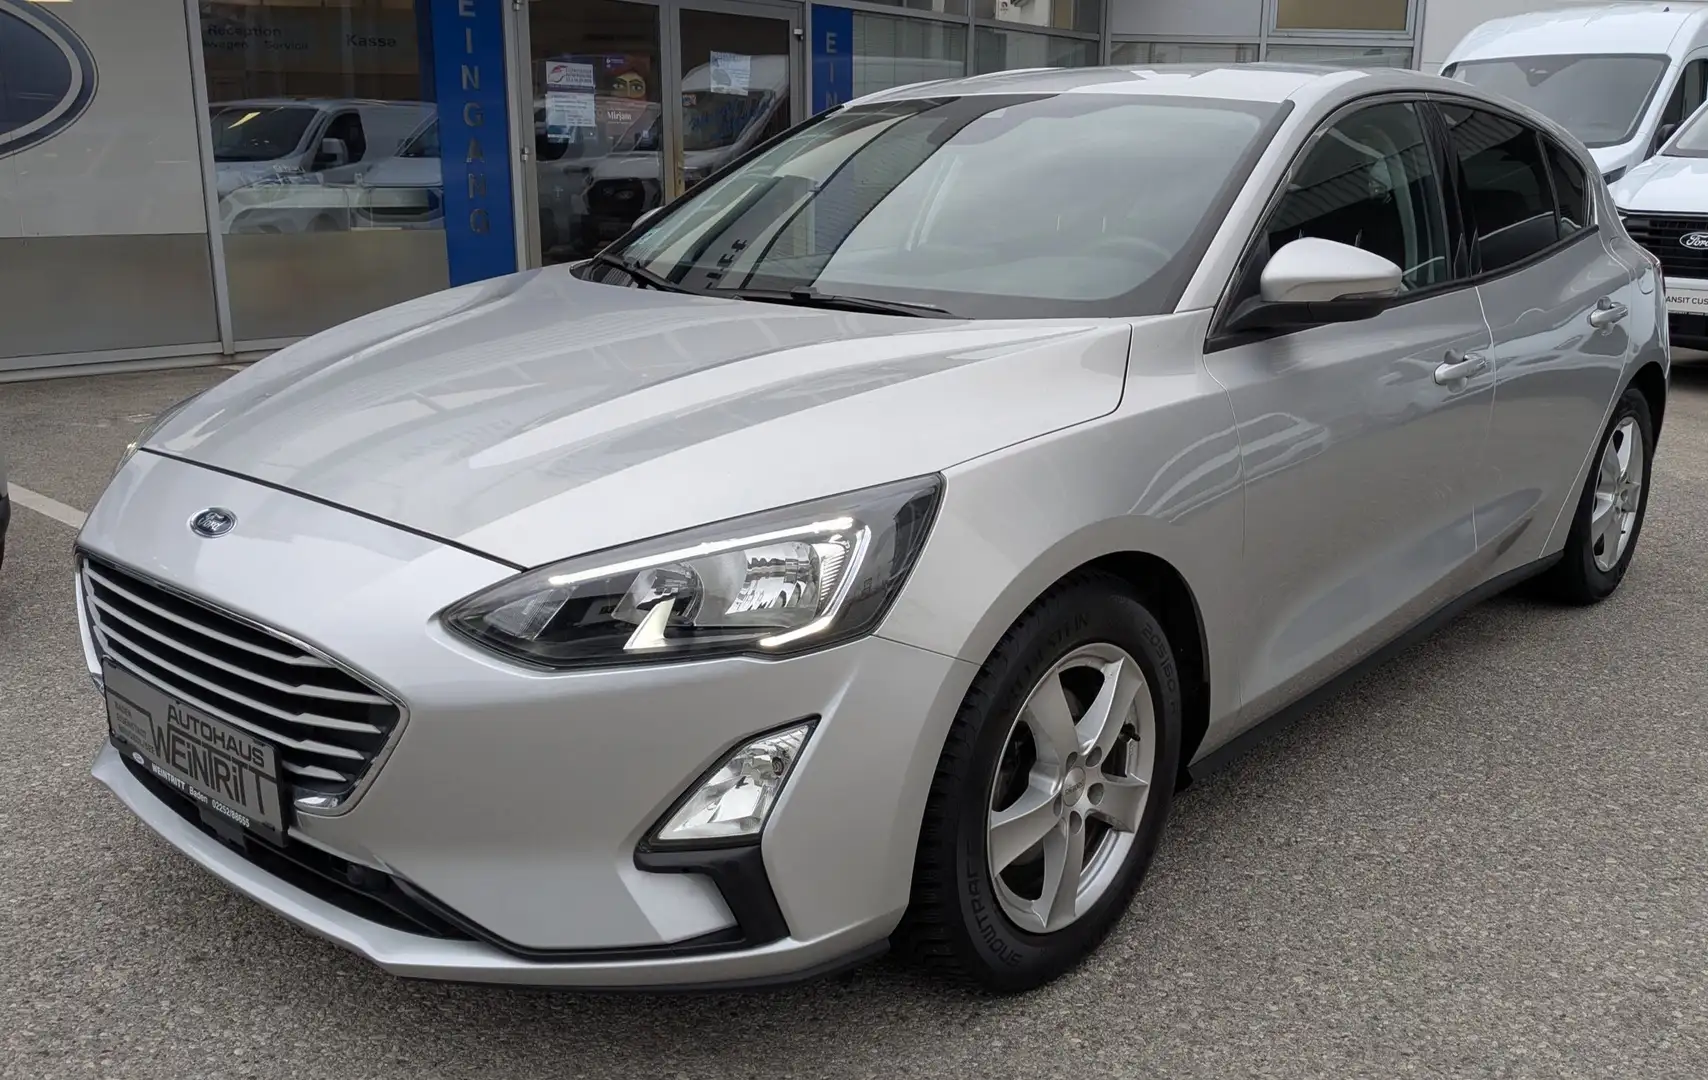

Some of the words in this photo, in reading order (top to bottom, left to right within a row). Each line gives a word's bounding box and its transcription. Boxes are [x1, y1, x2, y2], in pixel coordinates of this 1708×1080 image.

[208, 23, 282, 38] Reception
[197, 512, 227, 532] Ford
[167, 703, 265, 767] AUTOHAUS
[152, 763, 186, 791] WEINTRITT
[189, 785, 208, 804] Baden
